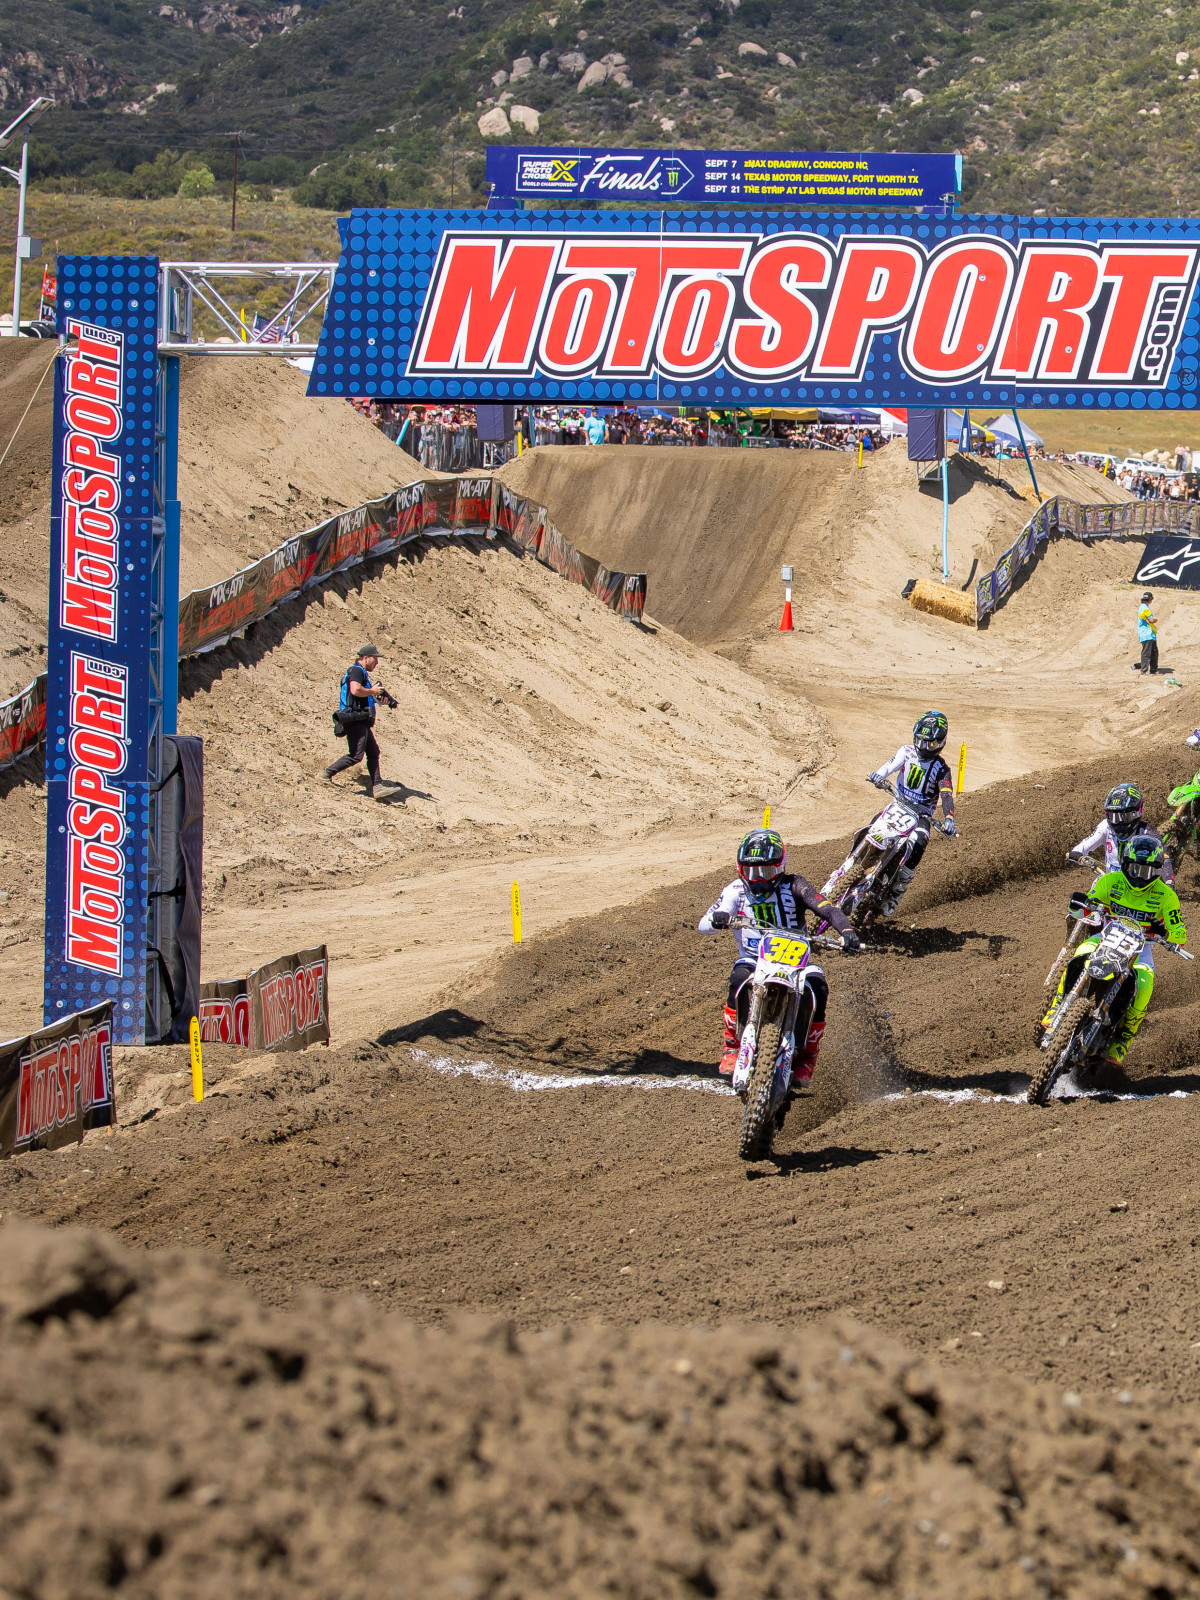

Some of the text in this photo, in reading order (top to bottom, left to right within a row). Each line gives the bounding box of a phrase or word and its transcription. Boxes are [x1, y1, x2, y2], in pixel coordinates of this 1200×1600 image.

[579, 154, 663, 193] Finals
[705, 159, 869, 170] SEPT 7 zMAX DRAGWAY, CONCORD NC
[704, 172, 919, 184] SEPT 14 TEXAS MOTOR SPEEDWAY, FORT WORTH TX
[704, 185, 924, 197] SEPT 21 THE STRIP AT LAS VEGAS MOTOR SPEEDWAY
[84, 326, 121, 344] .com
[1140, 285, 1187, 381] .com
[396, 490, 409, 512] MX
[459, 480, 472, 498] MX
[472, 480, 491, 498] ATV
[338, 514, 351, 537] MX
[352, 507, 368, 531] ATV
[273, 550, 286, 575] MX
[209, 584, 227, 609] MX
[228, 574, 245, 601] ATV
[65, 651, 128, 977] MOTOSPORT .com
[884, 808, 918, 833] 59
[763, 936, 809, 966] 38
[1102, 926, 1141, 958] 33
